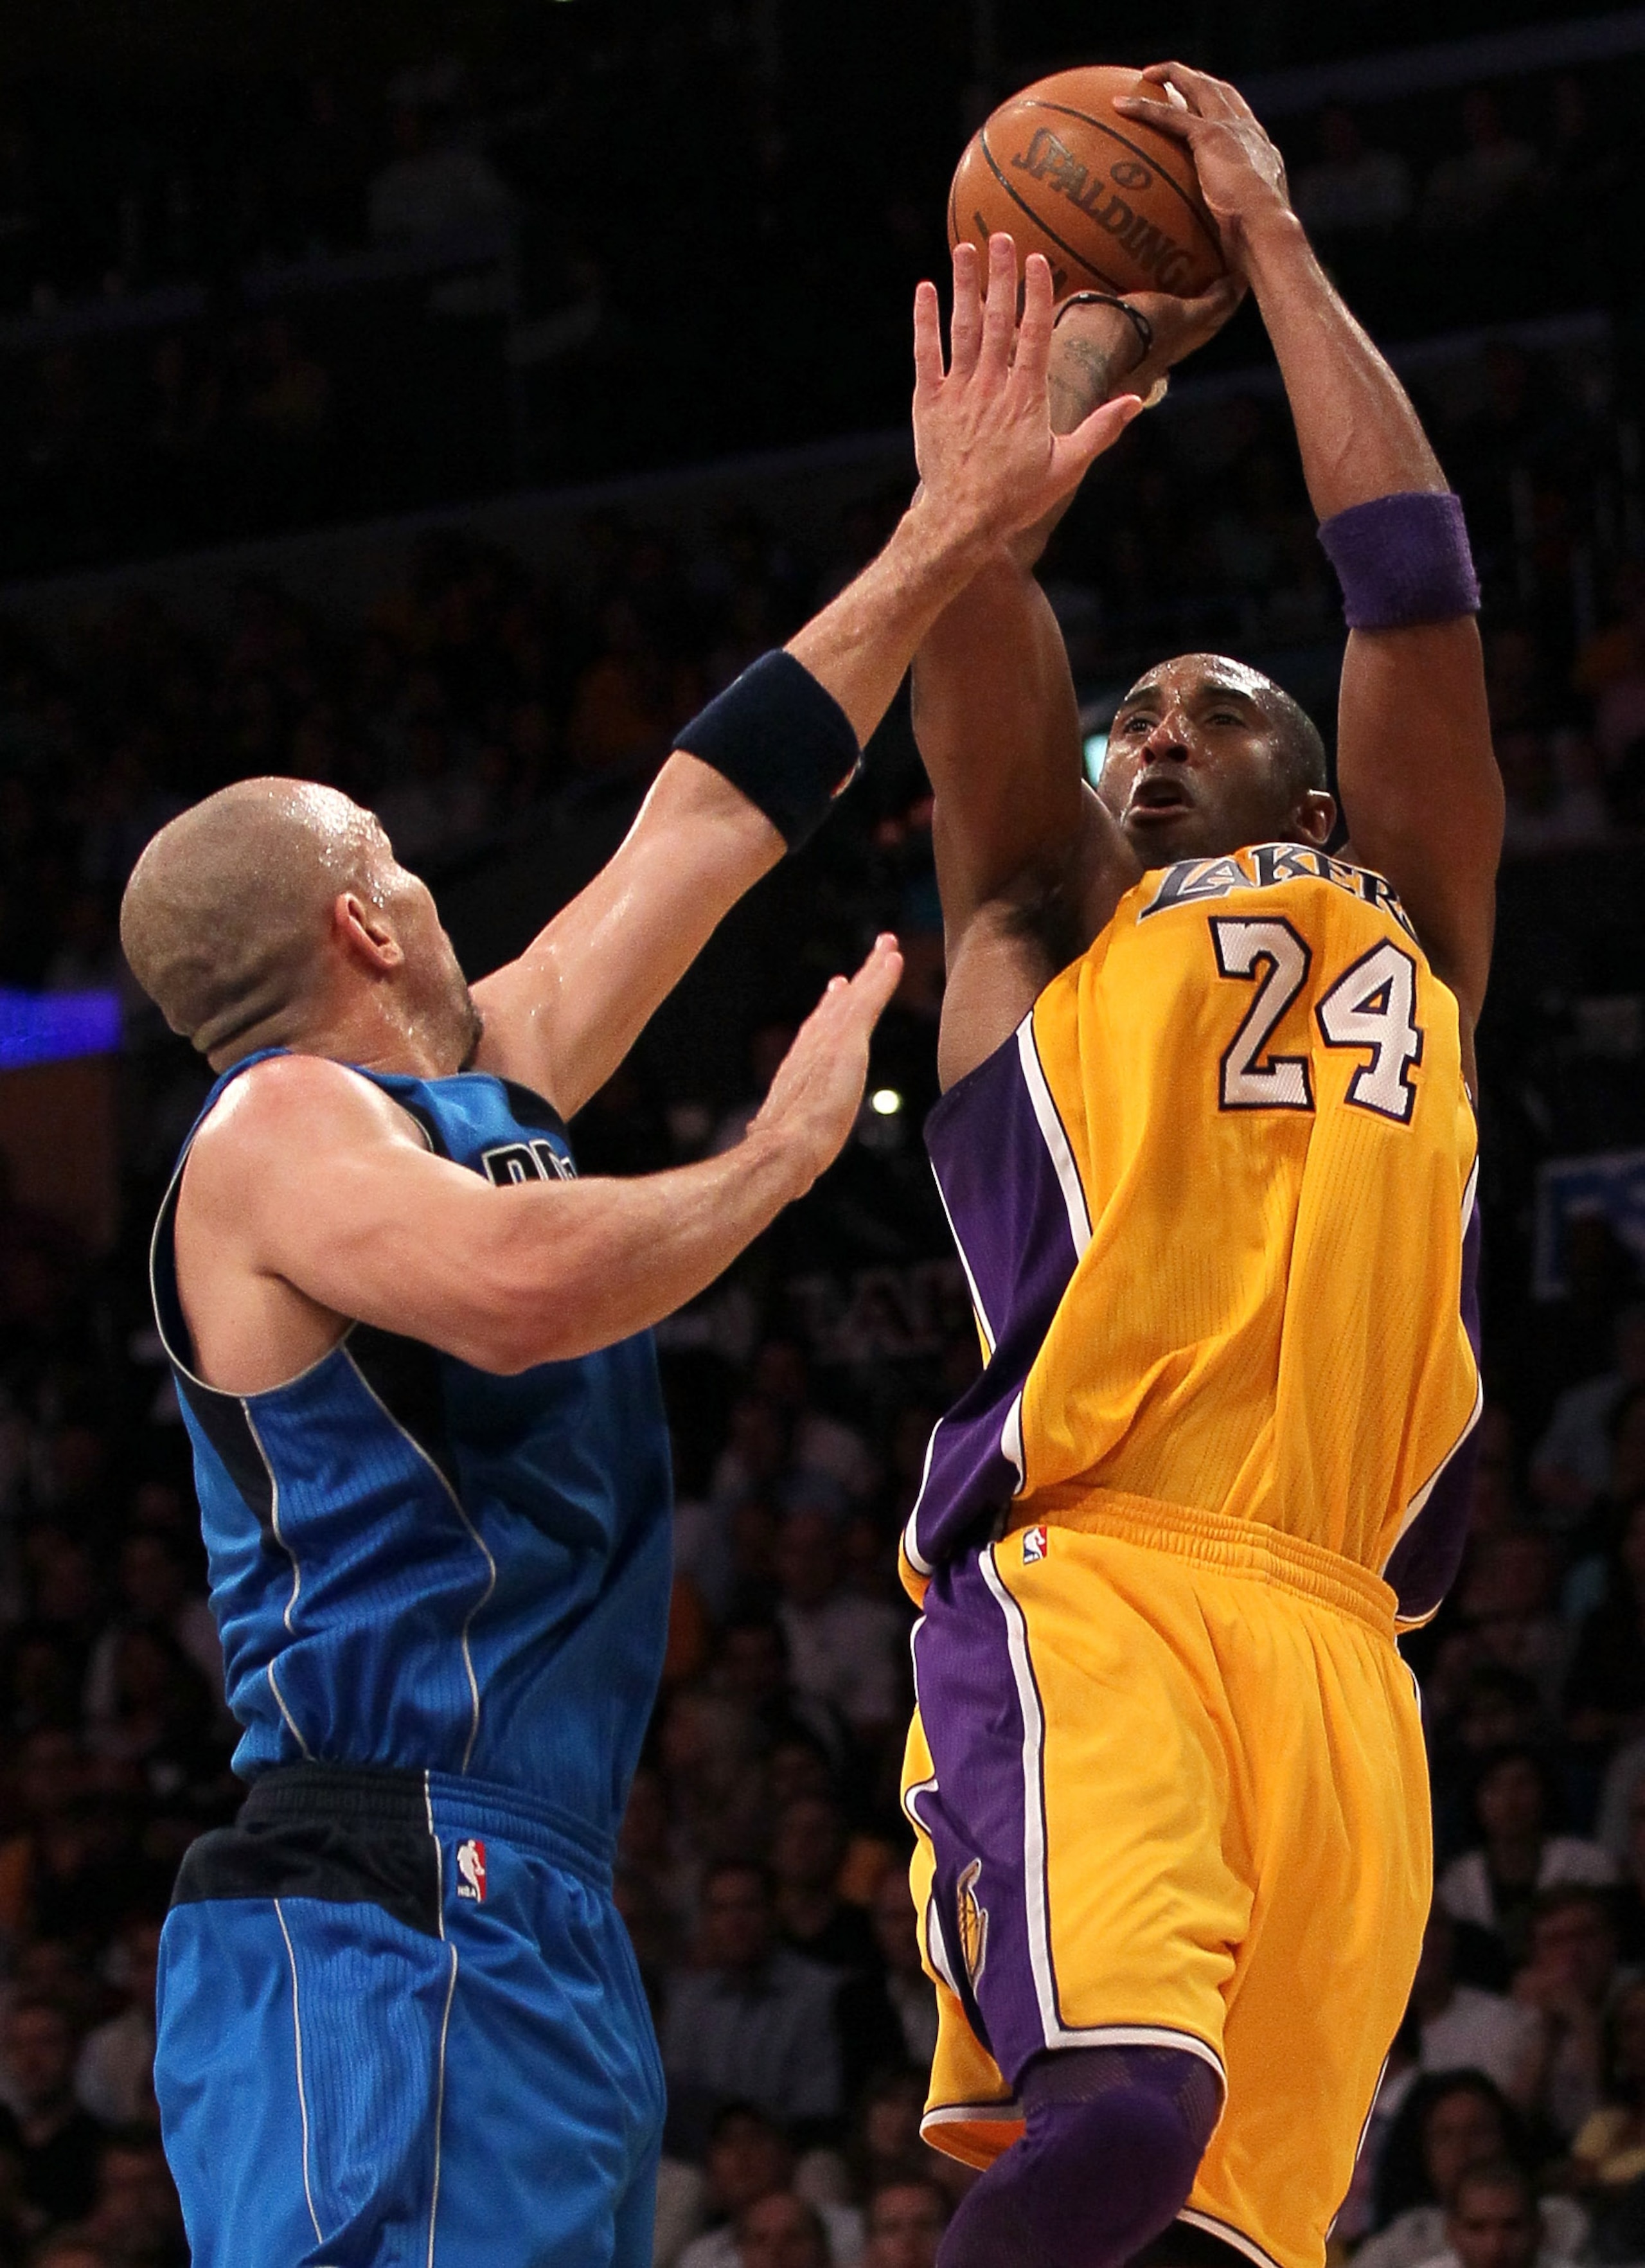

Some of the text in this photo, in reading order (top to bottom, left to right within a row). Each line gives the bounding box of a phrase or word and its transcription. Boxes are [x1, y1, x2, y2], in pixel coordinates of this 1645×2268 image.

[1011, 127, 1193, 289] SPALDING
[1137, 842, 1420, 945] LAKER
[1208, 916, 1423, 1125] 24
